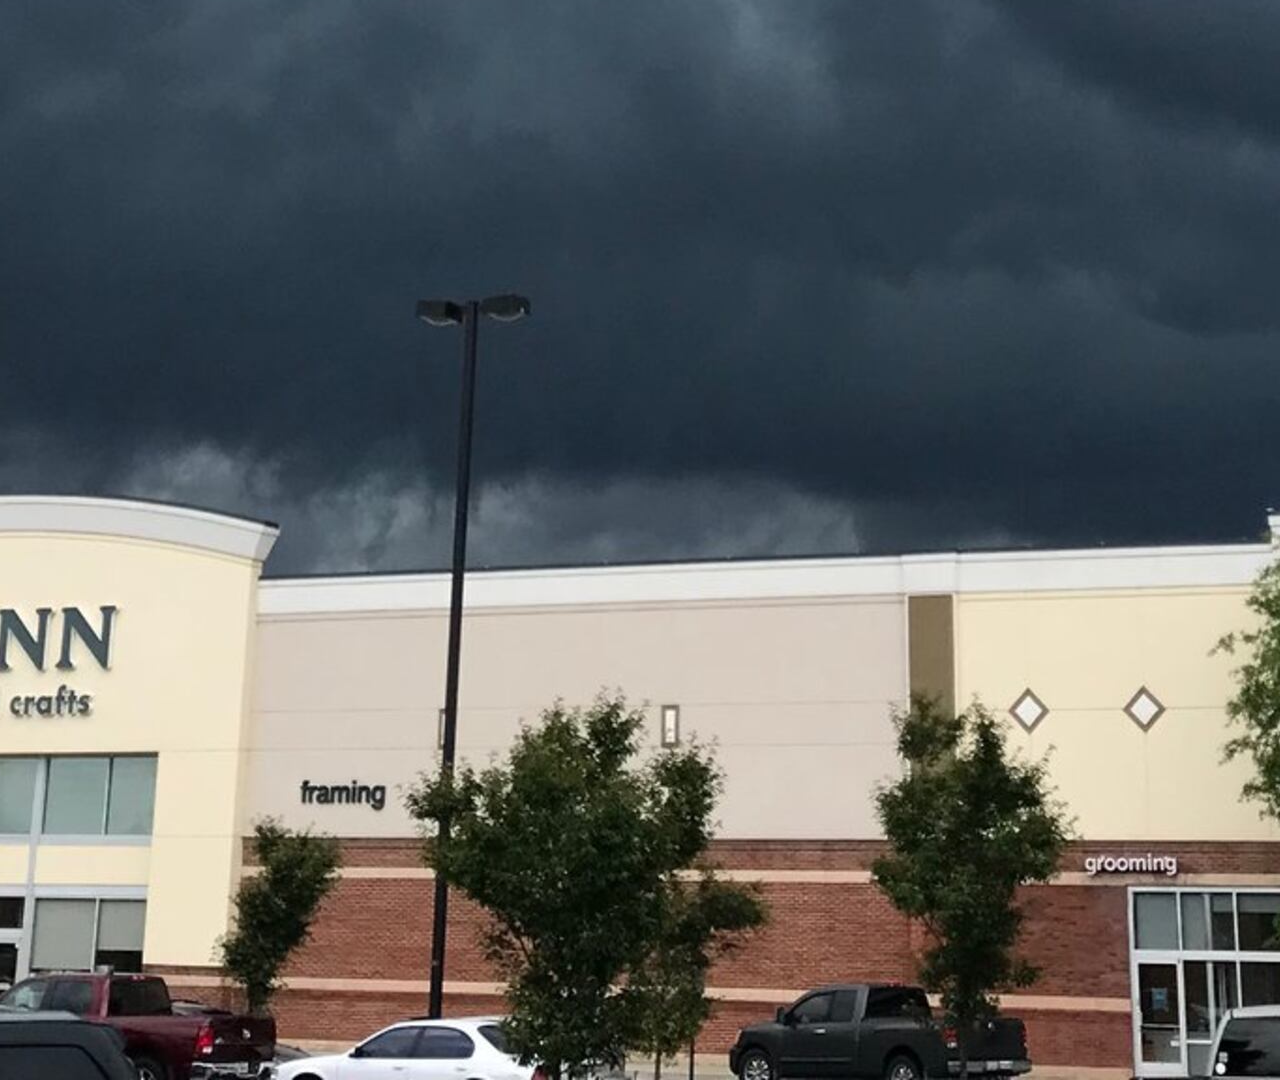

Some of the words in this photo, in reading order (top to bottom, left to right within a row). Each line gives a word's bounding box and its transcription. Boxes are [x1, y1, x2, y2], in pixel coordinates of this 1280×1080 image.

[9, 684, 92, 716] crafts
[300, 779, 386, 811] framing
[1084, 853, 1177, 876] grooming
